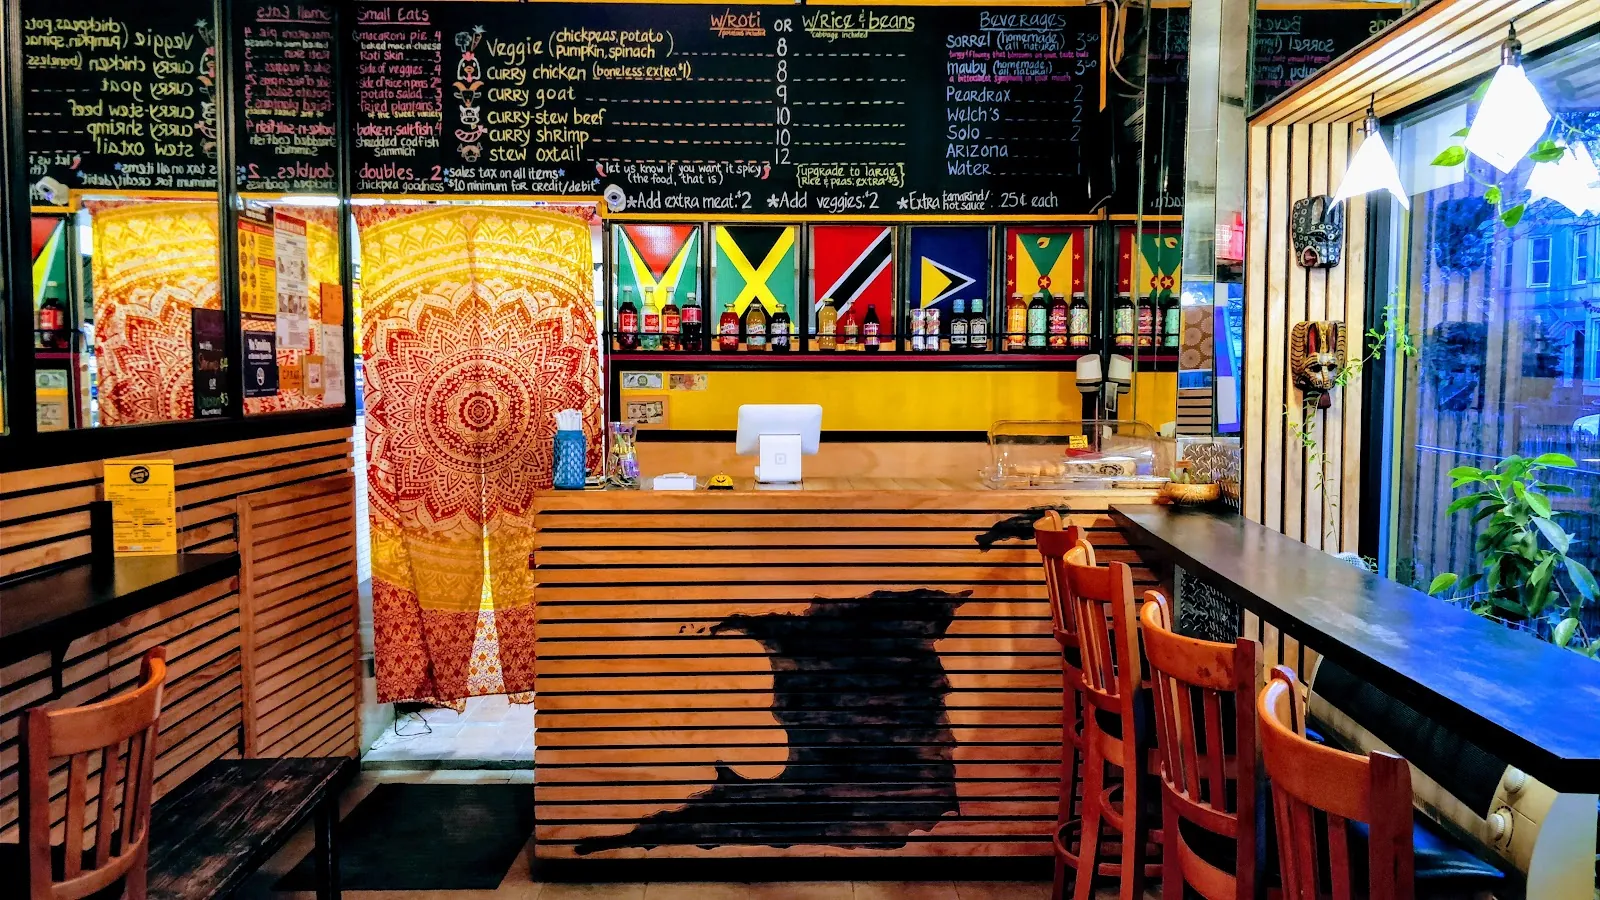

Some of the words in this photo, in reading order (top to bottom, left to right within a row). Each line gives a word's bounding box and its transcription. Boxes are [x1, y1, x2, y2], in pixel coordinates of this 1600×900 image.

[357, 6, 391, 21] Small
[398, 7, 430, 21] Eats
[774, 19, 793, 33] OR
[869, 11, 916, 31] beans
[410, 30, 428, 44] pie
[434, 31, 442, 42] 4
[361, 41, 387, 51] baked
[486, 37, 544, 66] Veggie
[776, 37, 788, 57] 8
[360, 51, 381, 61] Roti
[434, 51, 442, 63] 3
[388, 64, 423, 77] veggies
[434, 65, 442, 76] 4
[532, 62, 587, 81] chicken
[776, 60, 788, 83] 8
[947, 60, 987, 77] mauby
[434, 88, 442, 99] 3
[535, 86, 577, 109] goat
[776, 85, 787, 105] 9
[1073, 84, 1083, 102] 2
[434, 99, 443, 112] 3
[946, 106, 1000, 123] Welch's
[1071, 104, 1083, 123] 2
[573, 106, 607, 126] beef
[776, 106, 791, 126] 10
[434, 122, 442, 137] 4
[776, 128, 791, 146] 10
[946, 124, 980, 141] Solo
[1070, 125, 1082, 142] 2
[489, 146, 527, 162] stew
[536, 144, 581, 162] oxtail
[775, 148, 791, 165] 12
[358, 162, 414, 180] doubles
[430, 165, 442, 181] 2
[449, 166, 476, 179] sales
[478, 166, 498, 179] tax
[500, 169, 512, 179] on
[513, 167, 526, 179] all
[528, 167, 559, 180] items
[605, 162, 621, 174] let
[624, 165, 636, 174] us
[640, 163, 664, 174] know
[667, 162, 676, 174] if
[678, 165, 696, 177] you
[699, 163, 722, 174] want
[725, 162, 735, 174] it
[738, 162, 762, 178] spicy
[850, 164, 861, 177] to
[447, 179, 466, 192] $10
[680, 173, 705, 185] that
[1031, 191, 1059, 208] each
